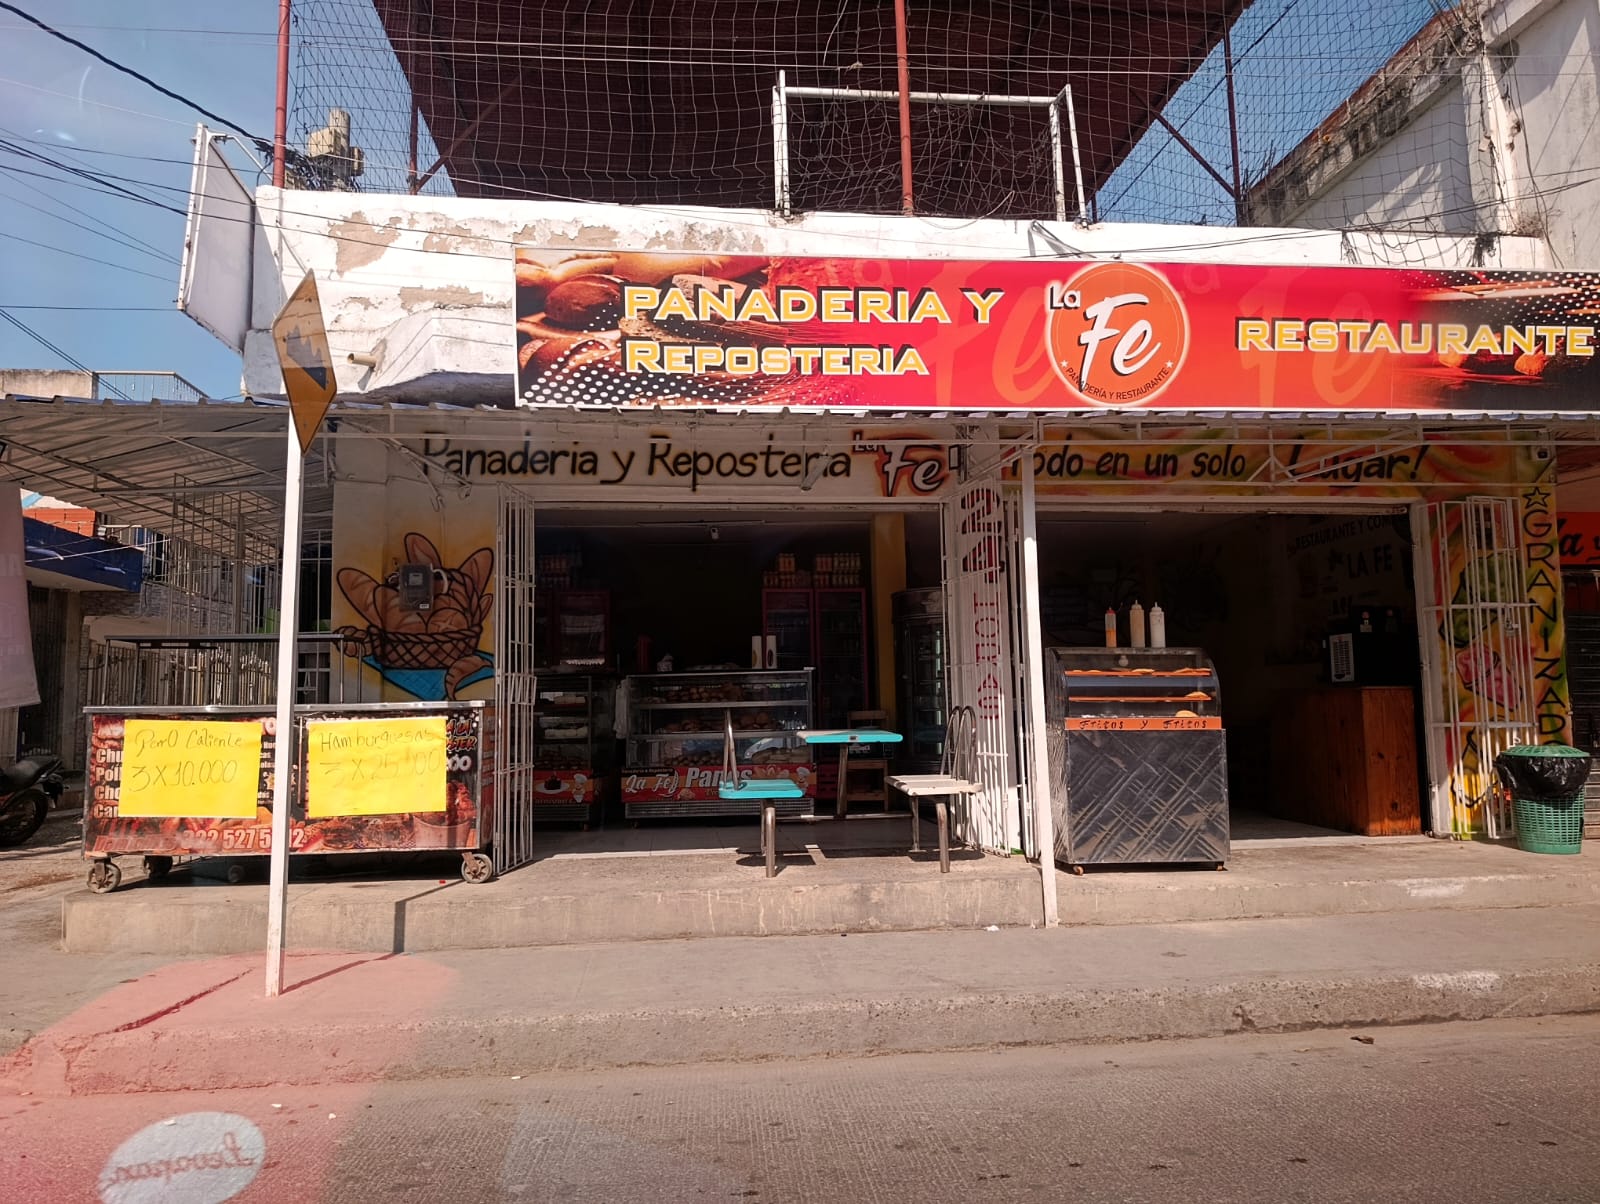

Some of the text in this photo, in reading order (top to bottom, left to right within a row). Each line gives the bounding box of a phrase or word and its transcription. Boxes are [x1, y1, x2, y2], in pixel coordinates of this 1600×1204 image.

[623, 285, 1005, 323] PANADERIA Y
[1050, 285, 1081, 309] La
[1078, 292, 1162, 393] Fe
[1234, 317, 1595, 356] RESTAURANTE
[624, 340, 929, 376] REPOSTERIA
[1109, 390, 1115, 400] Y
[1115, 368, 1169, 400] RESTAURANTE
[423, 430, 598, 477] Panaderia
[600, 450, 635, 484] y
[882, 436, 945, 497] Fe
[1096, 451, 1130, 476] en
[1144, 452, 1179, 477] un
[1191, 443, 1246, 478] solo
[1523, 509, 1568, 746] GRANIZAD
[223, 829, 256, 849] 527
